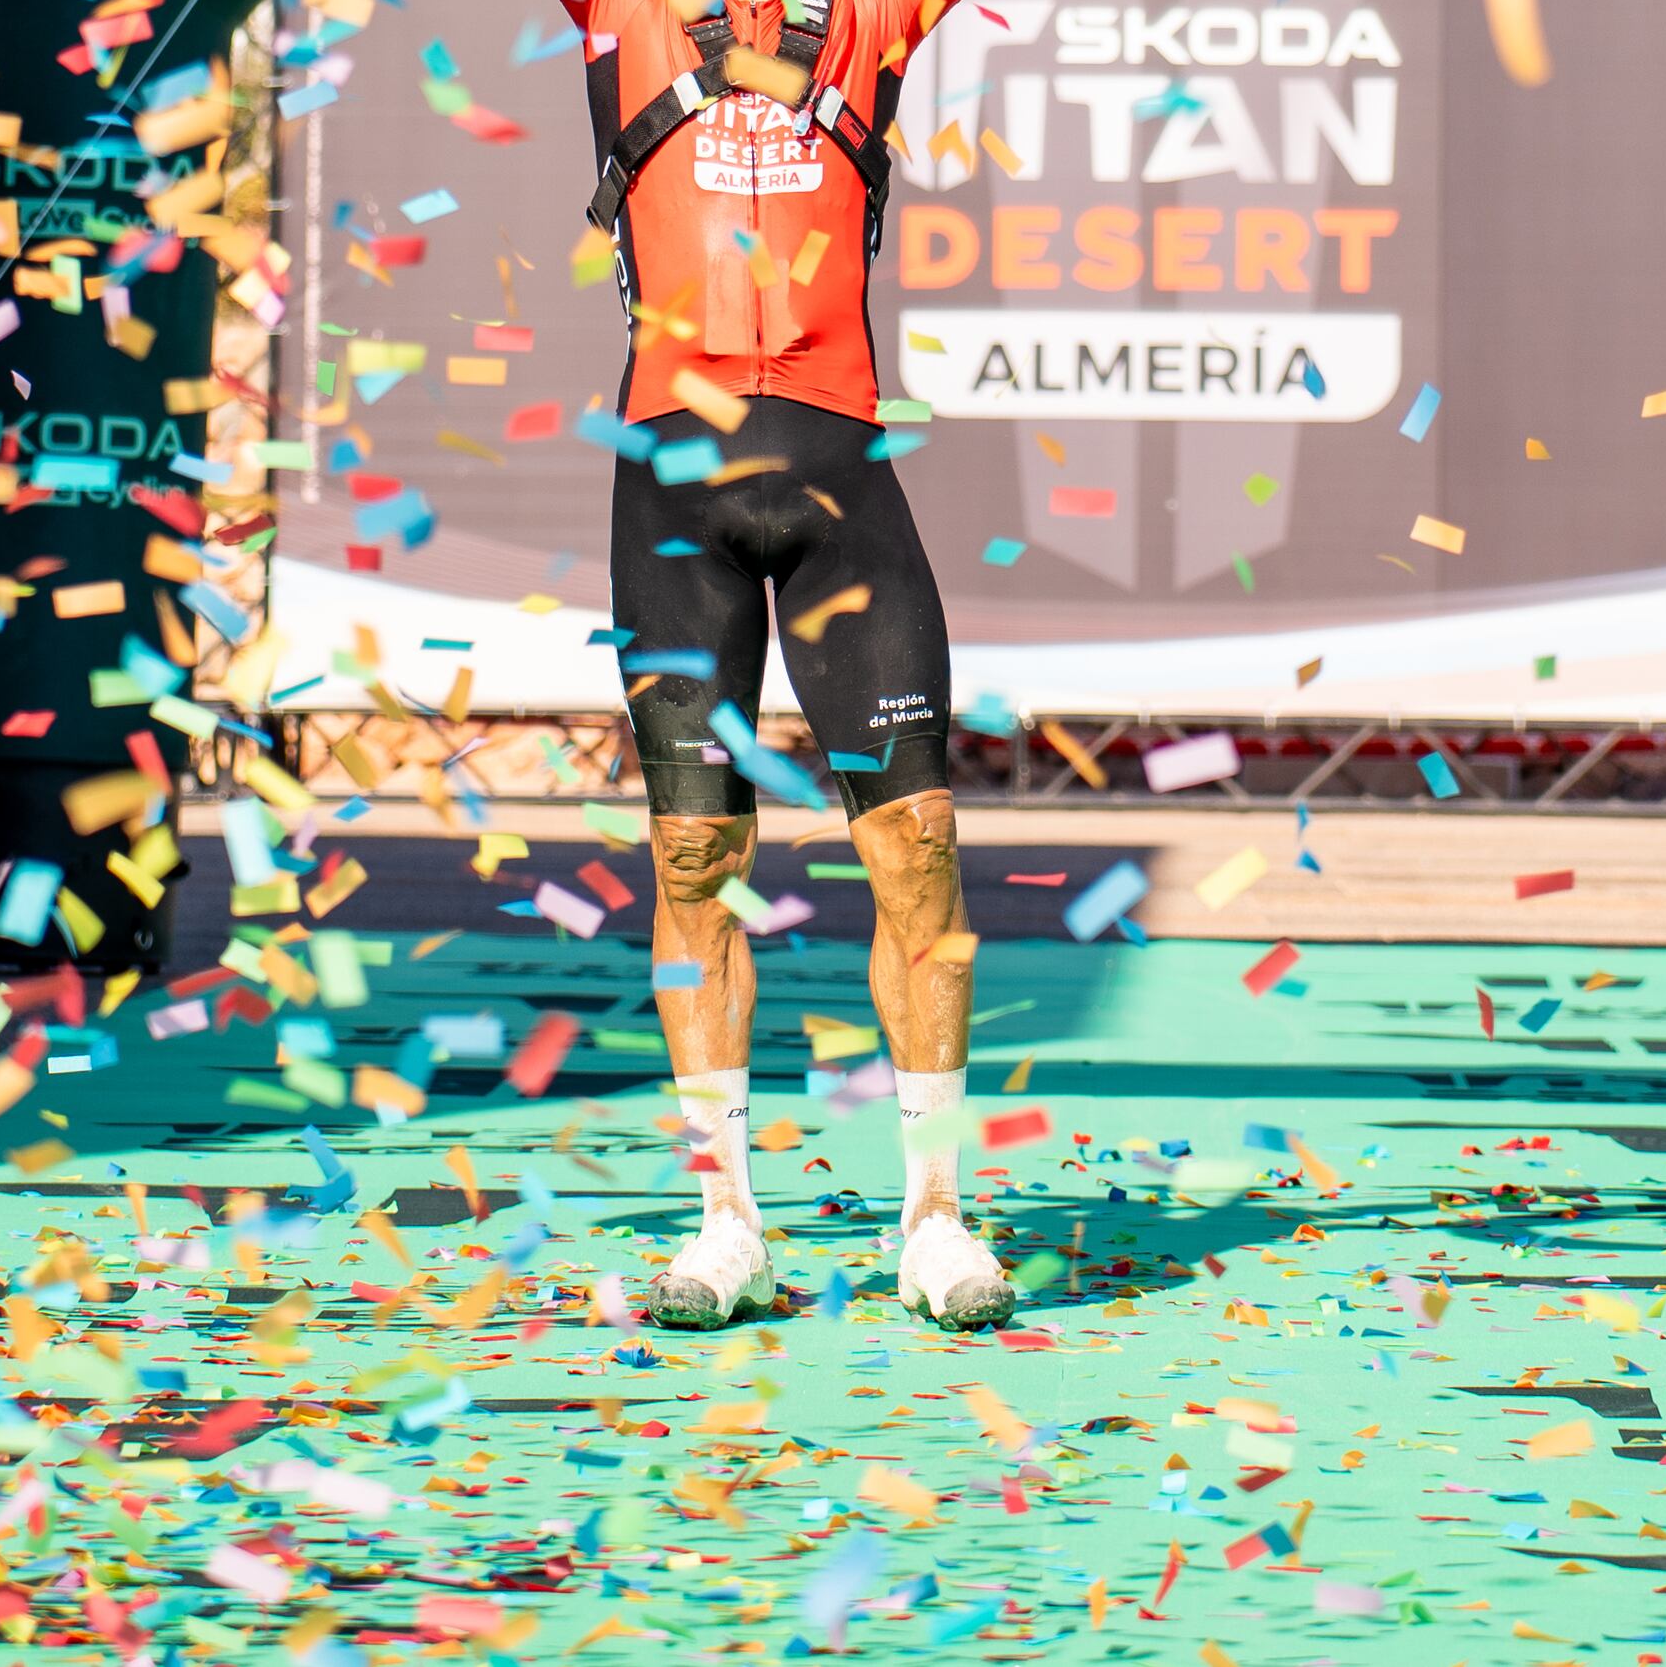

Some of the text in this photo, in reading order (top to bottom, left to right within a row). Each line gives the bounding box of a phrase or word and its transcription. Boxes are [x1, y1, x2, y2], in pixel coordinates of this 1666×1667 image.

[1055, 5, 1402, 68] SKODA
[695, 135, 823, 166] DESERT
[899, 205, 1401, 295] DESERT
[972, 327, 1326, 400] ALMERÍA
[869, 707, 934, 729] de Murcia
[878, 693, 927, 712] Región
